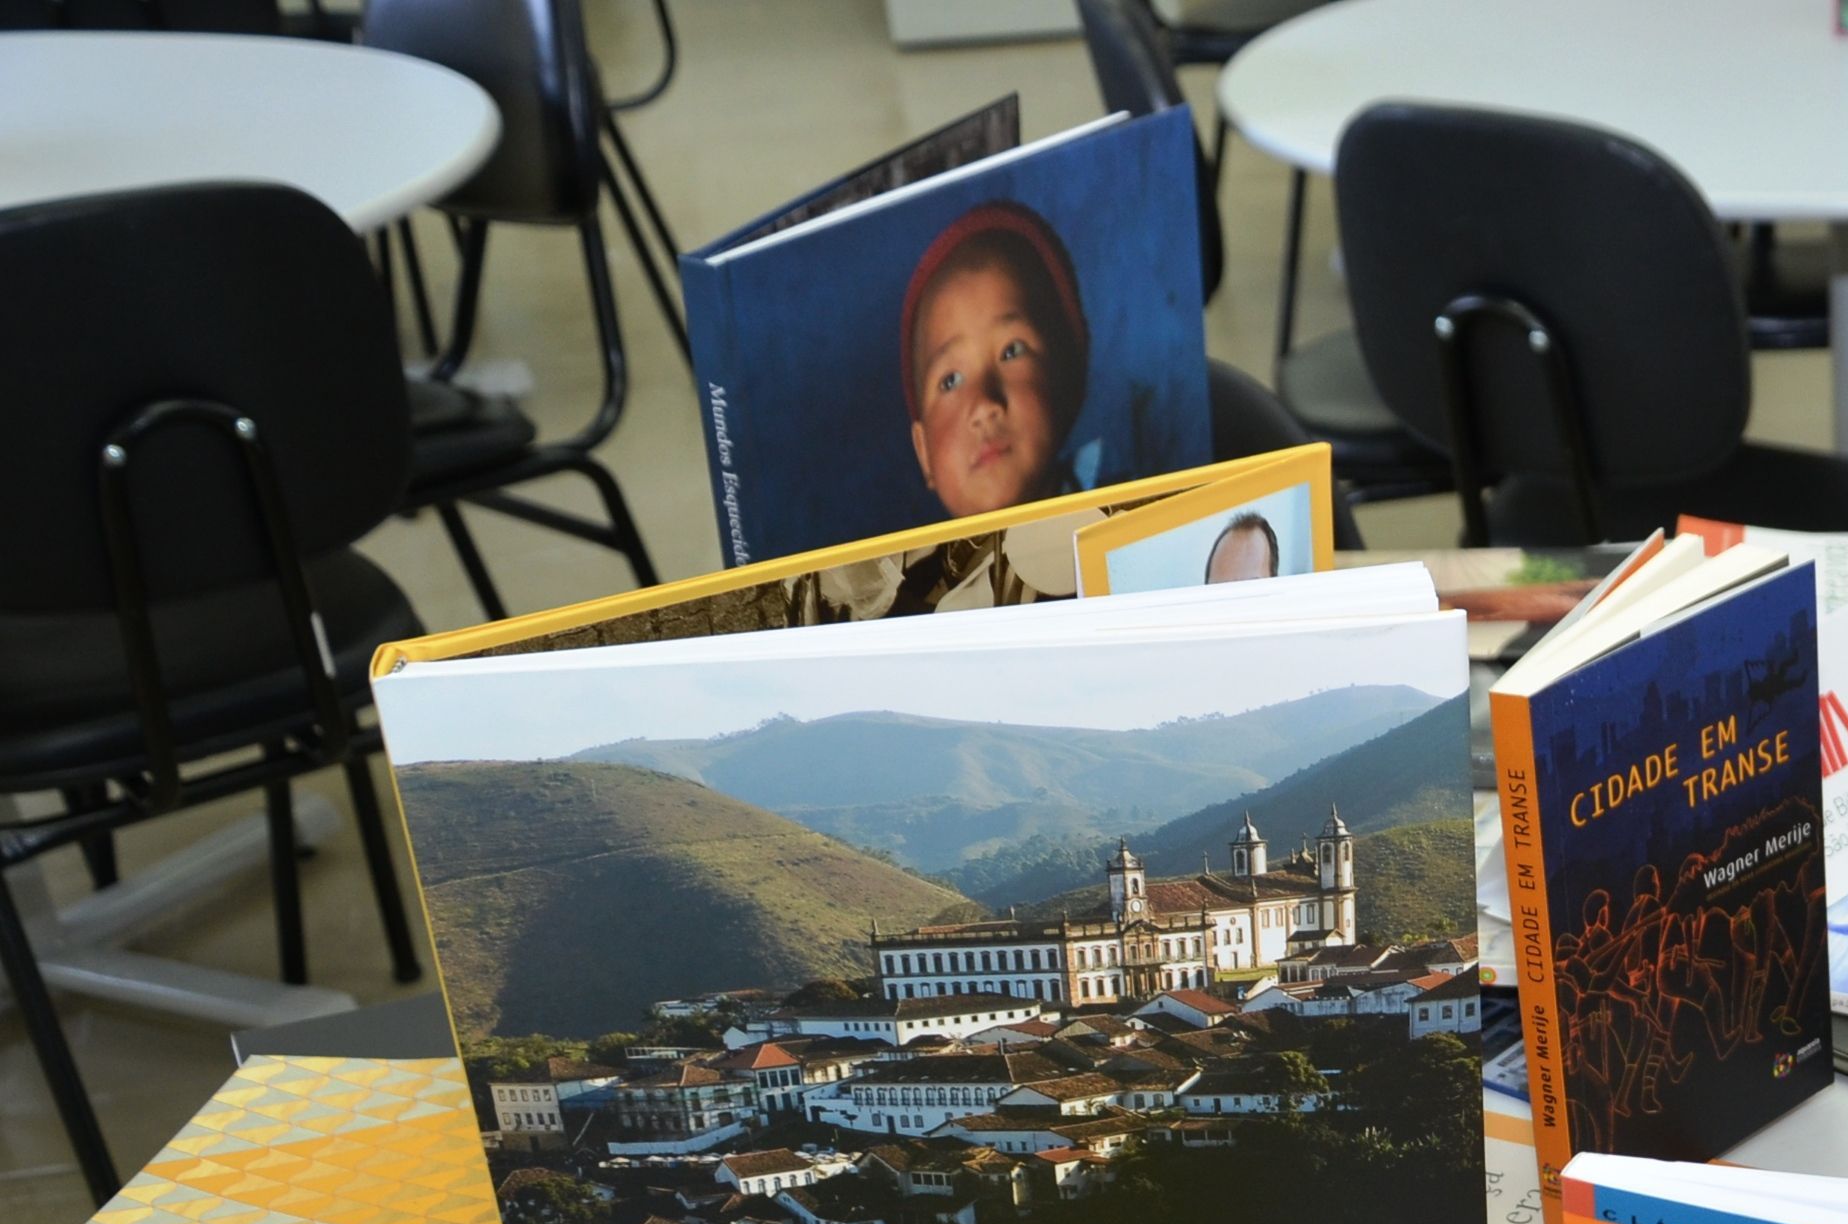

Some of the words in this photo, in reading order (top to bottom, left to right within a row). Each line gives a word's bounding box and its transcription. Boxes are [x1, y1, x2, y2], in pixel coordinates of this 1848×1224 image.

[708, 382, 735, 467] Mundos
[1569, 743, 1679, 828] CIDADE
[1700, 714, 1737, 760] EM
[1682, 730, 1790, 808] TRANSE
[1507, 768, 1529, 850] TRANSE
[1517, 864, 1536, 891] EM
[1703, 848, 1759, 889] Wagner
[1764, 821, 1812, 857] Merije
[1516, 905, 1545, 983] CIDADE
[1534, 1005, 1551, 1065] Merije
[1542, 1071, 1557, 1128] Wagner
